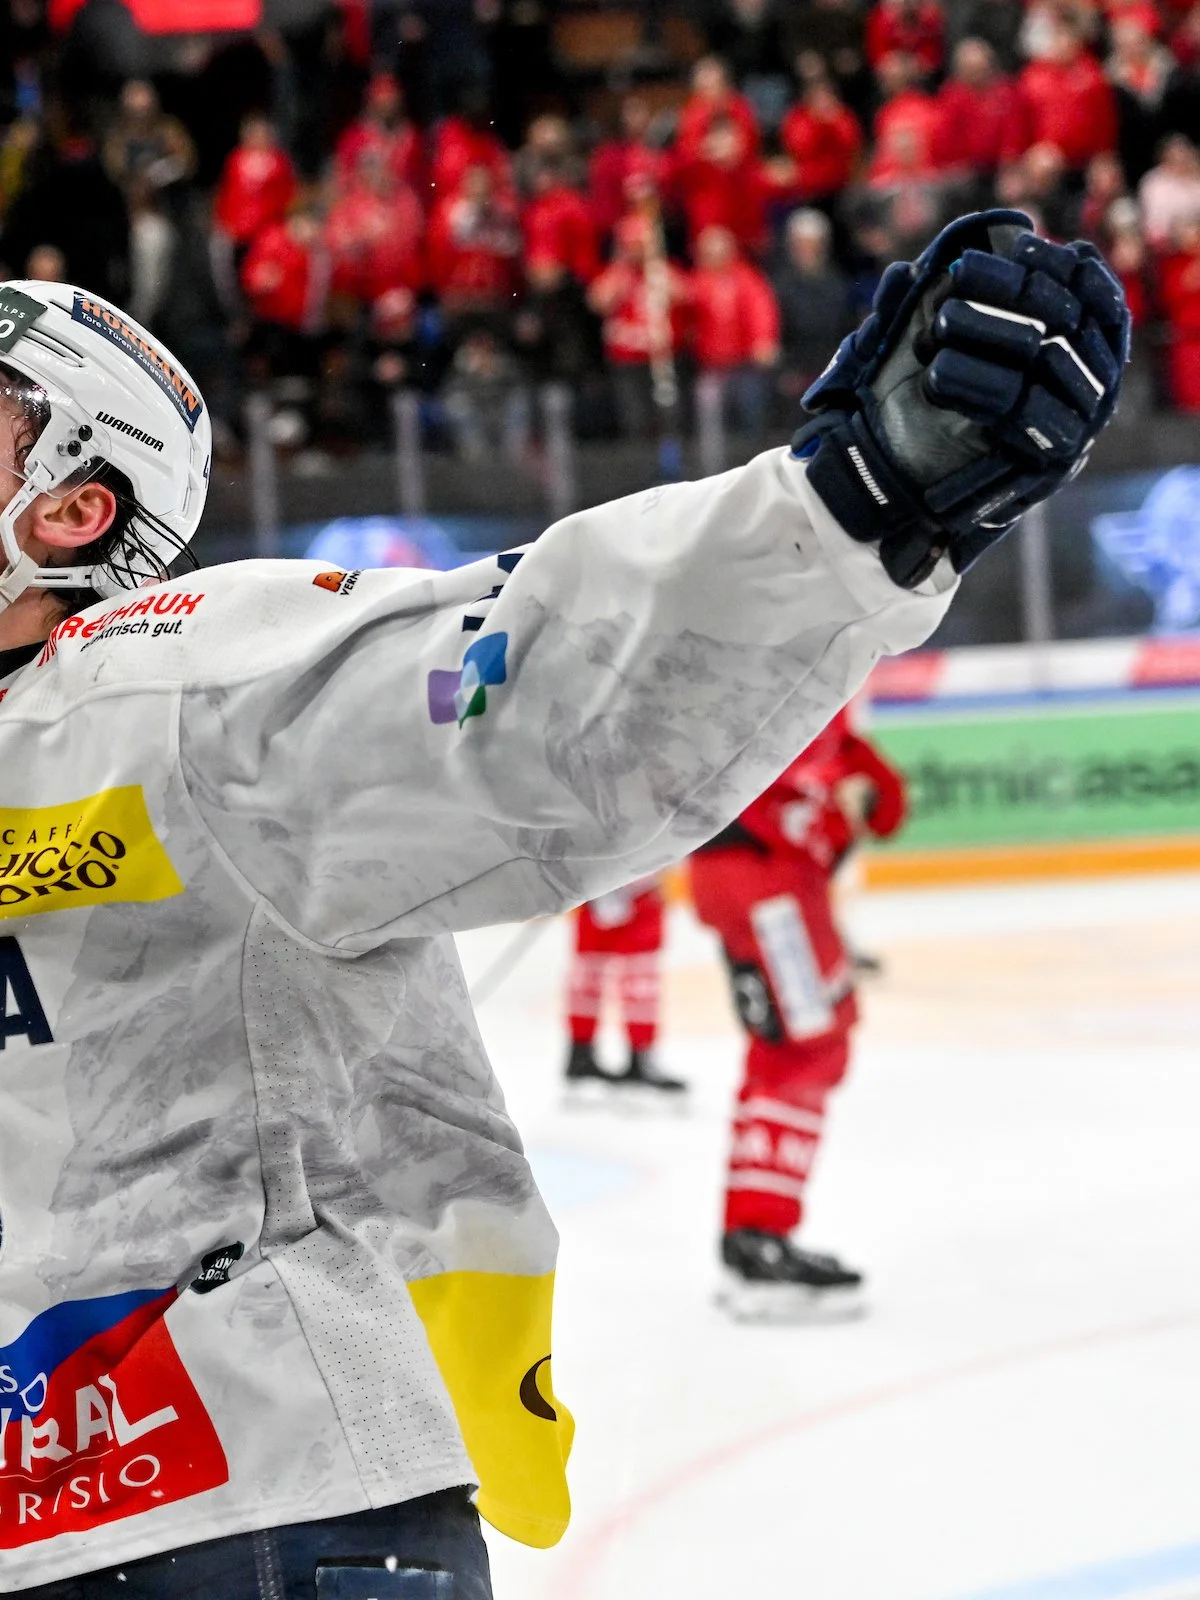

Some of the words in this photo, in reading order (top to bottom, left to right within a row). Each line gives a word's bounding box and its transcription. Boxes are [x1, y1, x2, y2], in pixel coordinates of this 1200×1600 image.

[81, 311, 102, 328] Tore
[107, 328, 133, 351] Türen
[136, 351, 165, 383] Zargen
[95, 410, 166, 453] WARRIOR
[846, 445, 890, 506] WARRIOR
[151, 619, 183, 638] gut.
